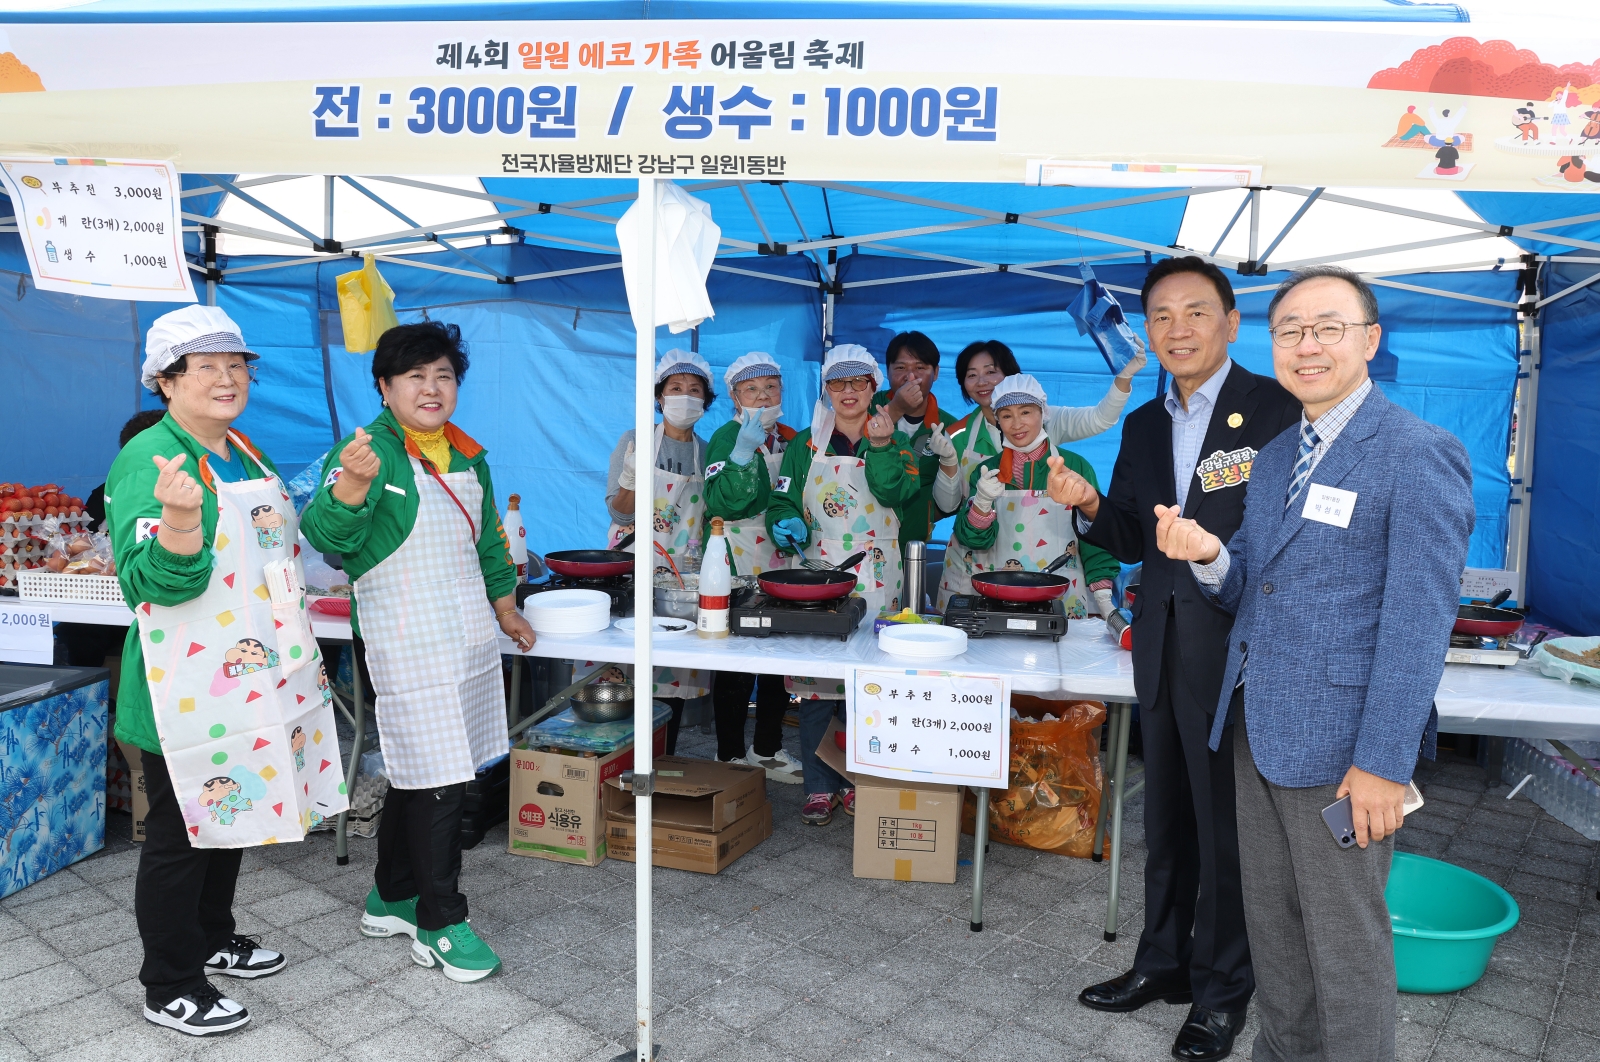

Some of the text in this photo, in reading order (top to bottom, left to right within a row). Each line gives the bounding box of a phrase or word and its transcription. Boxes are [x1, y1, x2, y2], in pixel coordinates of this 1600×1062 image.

[435, 38, 865, 70] 제4회 일원 에코 가족 어울림 축제
[312, 85, 361, 138] 전
[406, 85, 578, 139] 3000원
[662, 84, 773, 140] 생수
[824, 86, 998, 142] 1000원
[500, 153, 787, 176] 전국자율방재단 강남구 일원1동반
[114, 186, 163, 200] 3,000원
[123, 220, 165, 235] 2,000원
[123, 254, 168, 269] 1,000원
[1203, 450, 1251, 472] 강남구청장
[1, 612, 50, 628] 2,000원
[950, 693, 993, 705] 3,000원
[950, 720, 992, 733] 2,000원
[949, 748, 991, 761] 1,000원
[520, 809, 543, 823] 해표
[547, 811, 582, 830] 식용유
